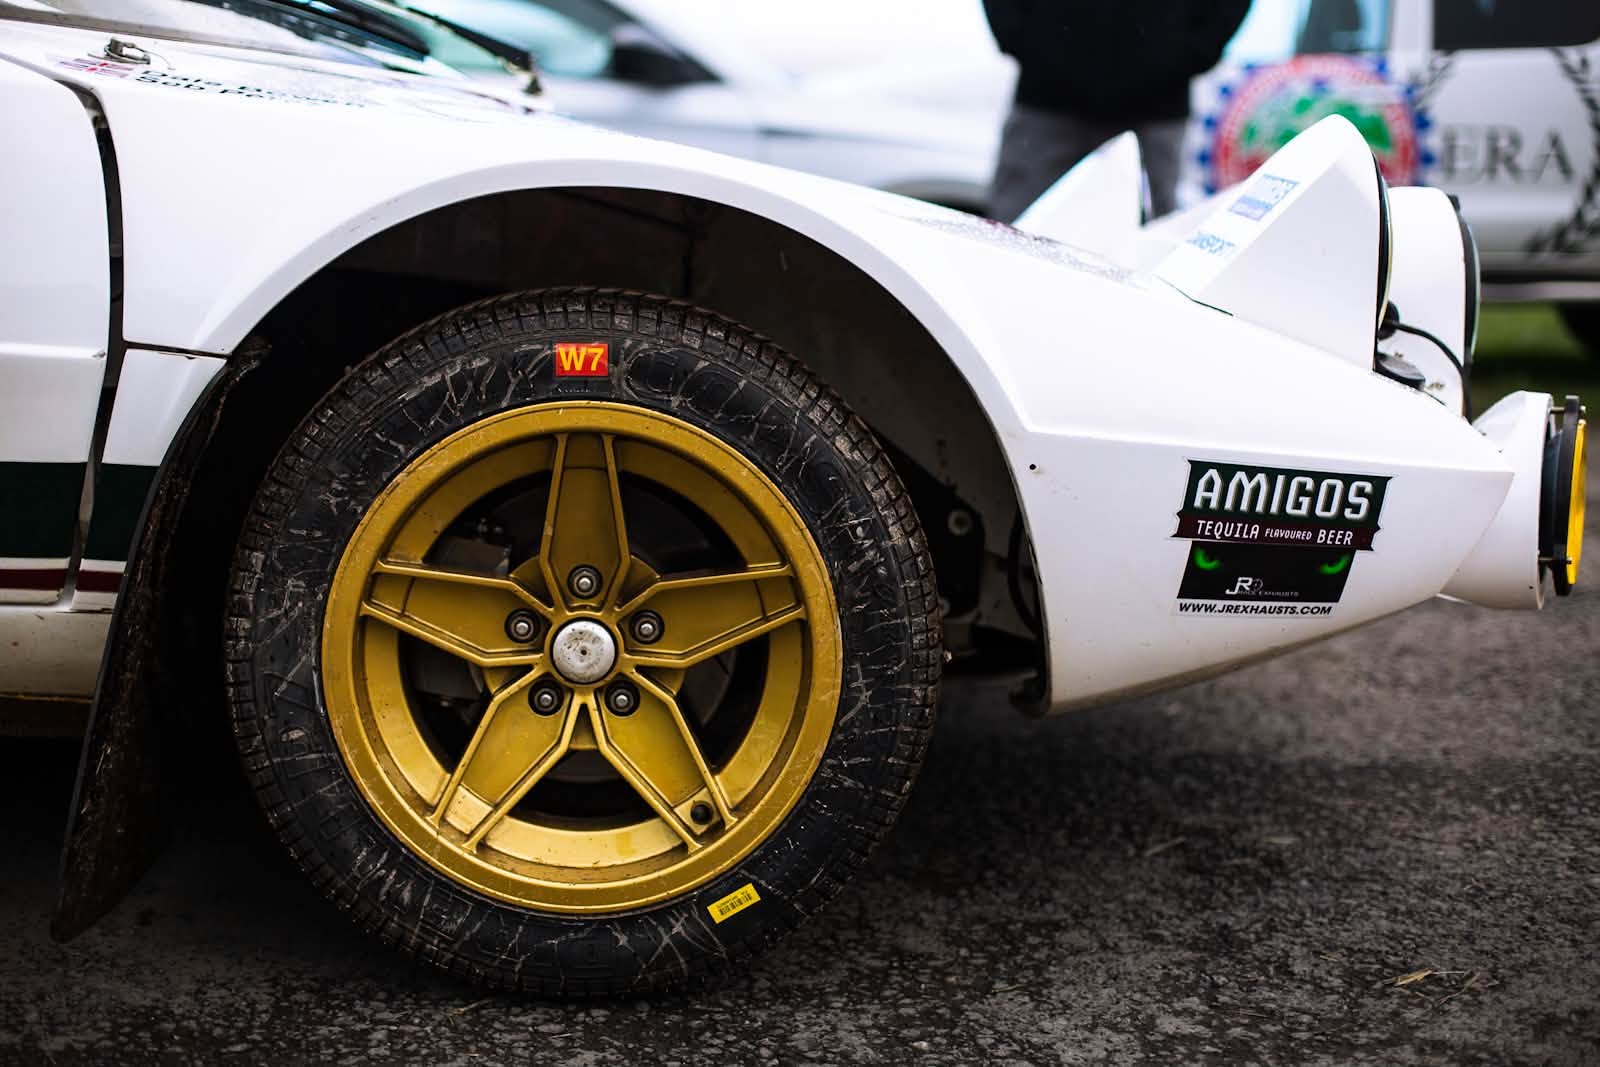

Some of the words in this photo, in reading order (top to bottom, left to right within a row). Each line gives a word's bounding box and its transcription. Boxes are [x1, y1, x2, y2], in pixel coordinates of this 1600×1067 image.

[1442, 125, 1574, 182] ERA
[560, 346, 604, 371] W7
[1193, 468, 1373, 520] AMIGOS
[1197, 520, 1260, 539] TEQUILA
[1264, 528, 1312, 540] FLAVOURED
[1317, 530, 1354, 545] BEER
[1179, 603, 1332, 615] WWW.JREXHAUSTS.COM
